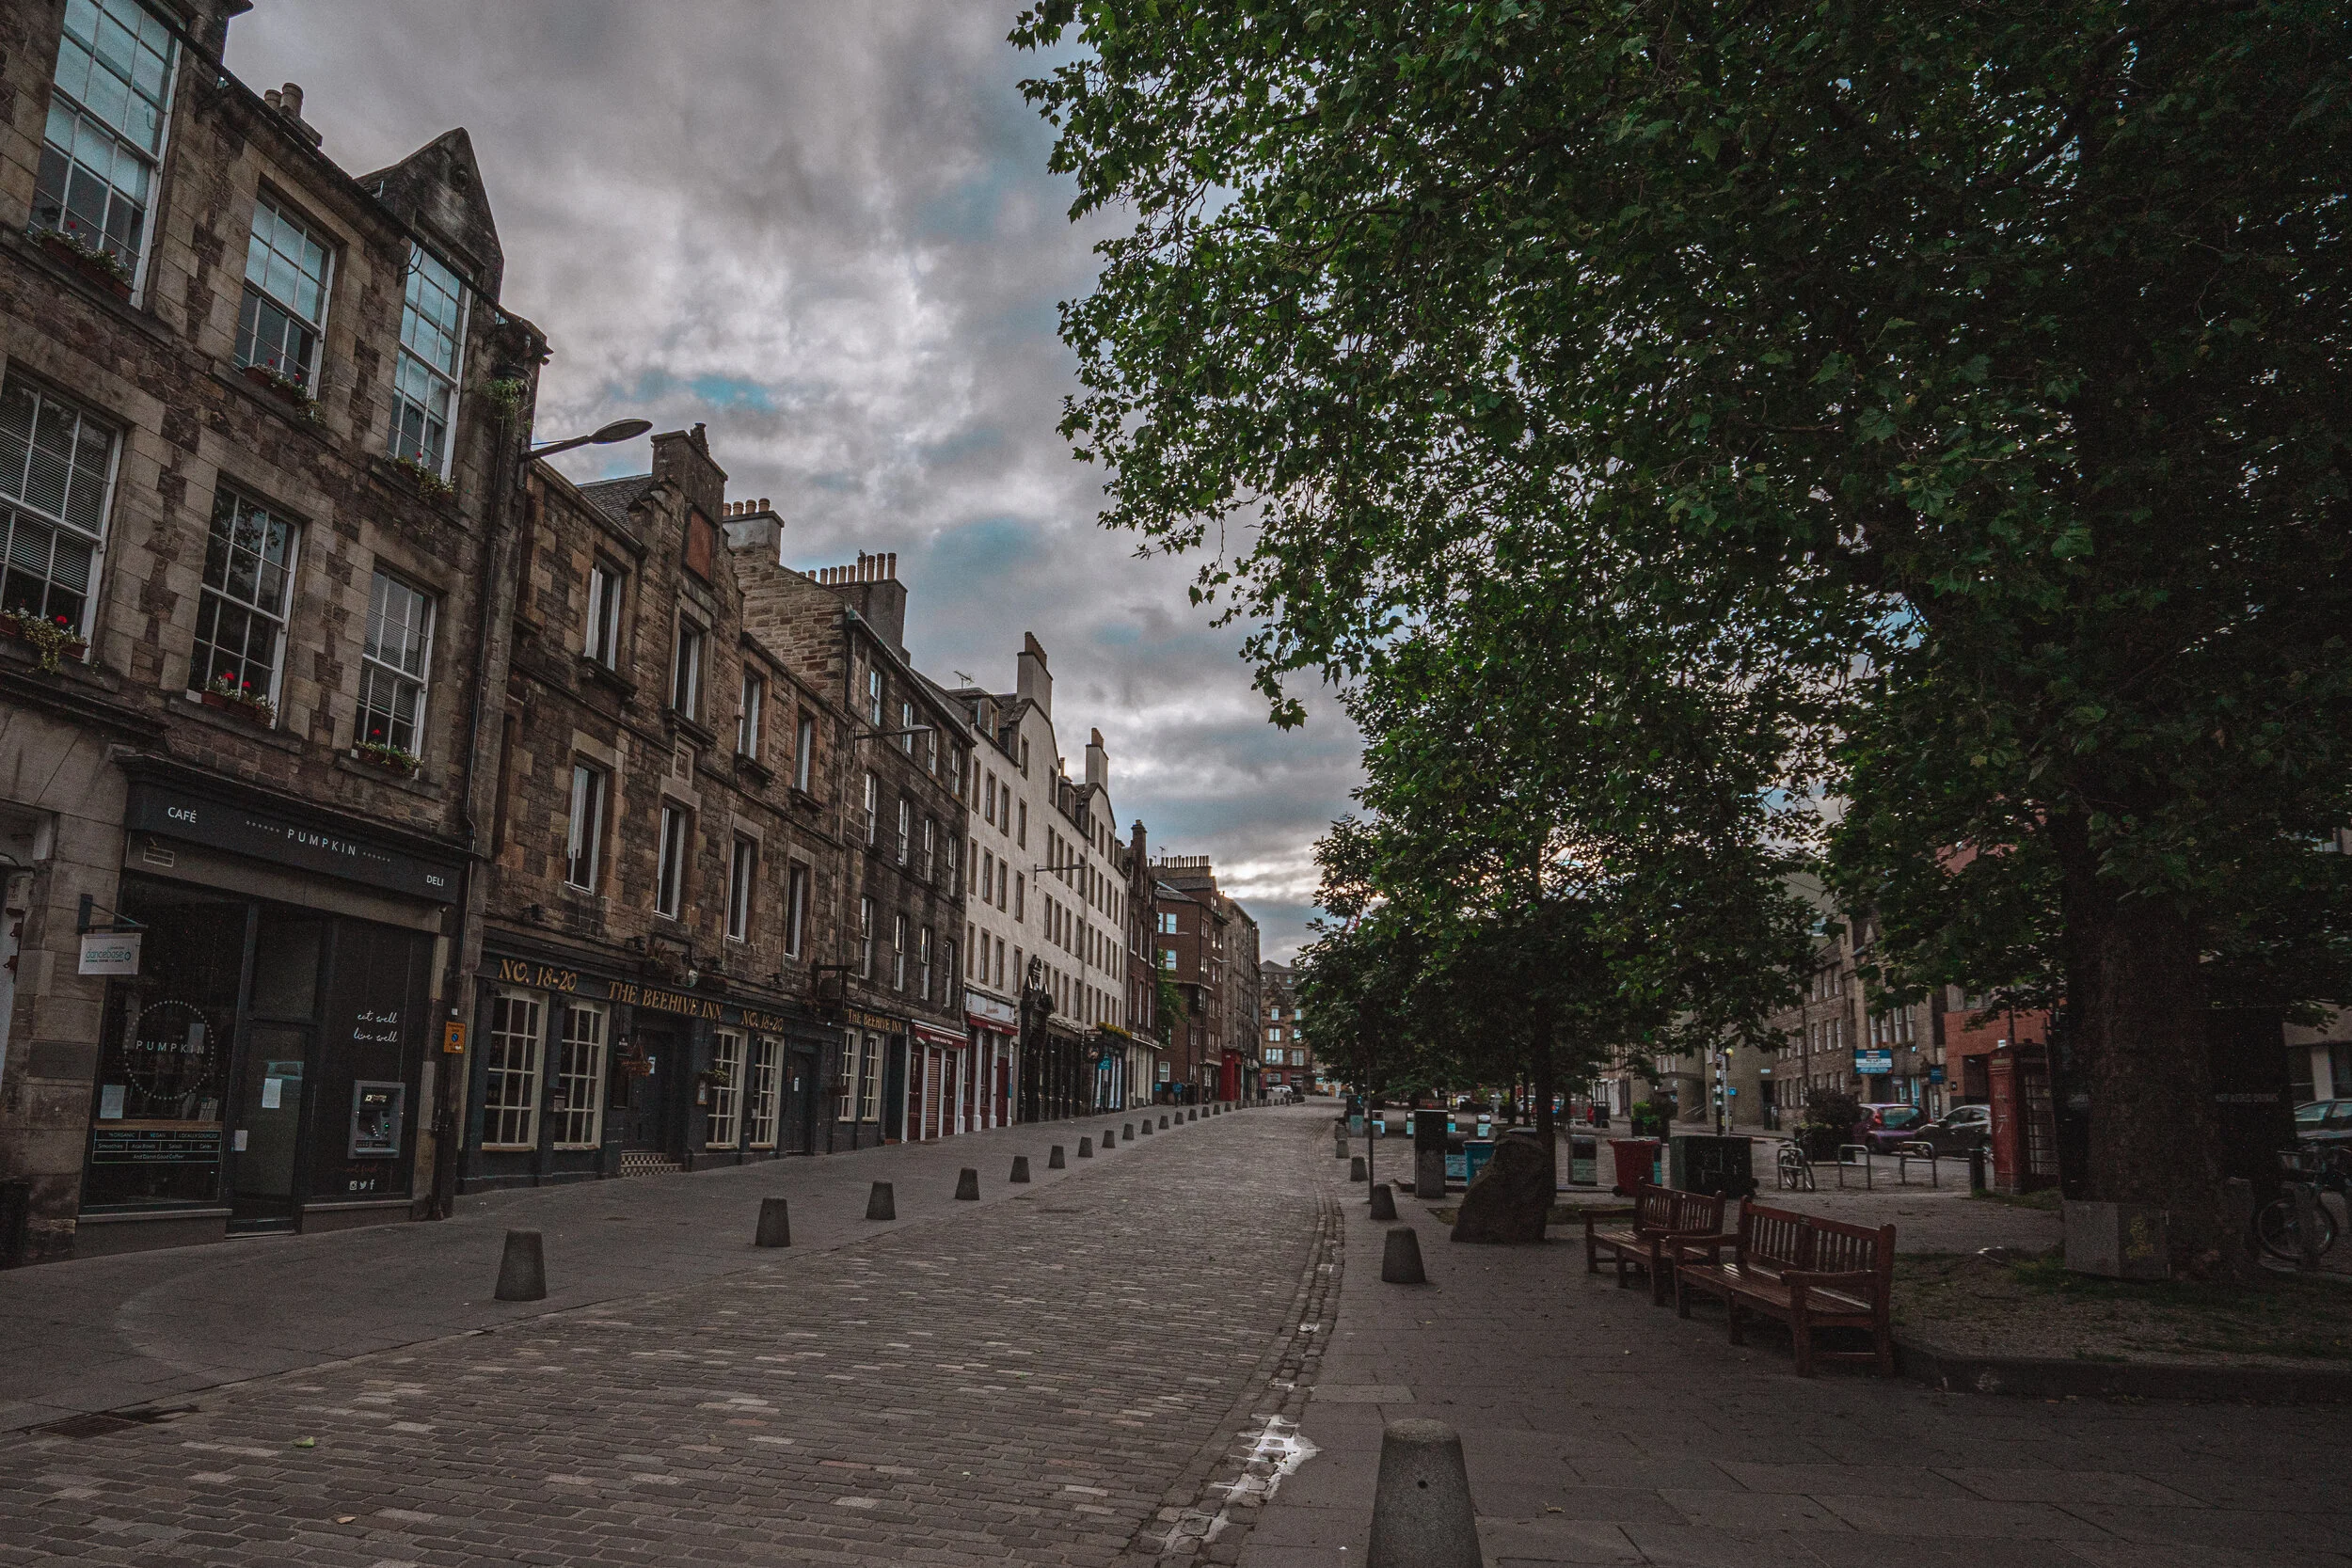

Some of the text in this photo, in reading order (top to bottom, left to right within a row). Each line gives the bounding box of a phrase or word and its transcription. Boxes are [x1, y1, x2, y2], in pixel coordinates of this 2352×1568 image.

[167, 807, 197, 823] CAFÉ
[287, 829, 357, 856] PUMPKIN
[426, 875, 444, 887] DELI
[499, 958, 577, 992] NO. 18-20
[608, 980, 723, 1021] THE BEEHIVE INN
[357, 1009, 397, 1023] eat well
[741, 1009, 758, 1027] NO.
[848, 1007, 903, 1034] THE BEEHIVE INN
[353, 1026, 397, 1042] live well
[135, 1039, 205, 1054] PUMPKIN
